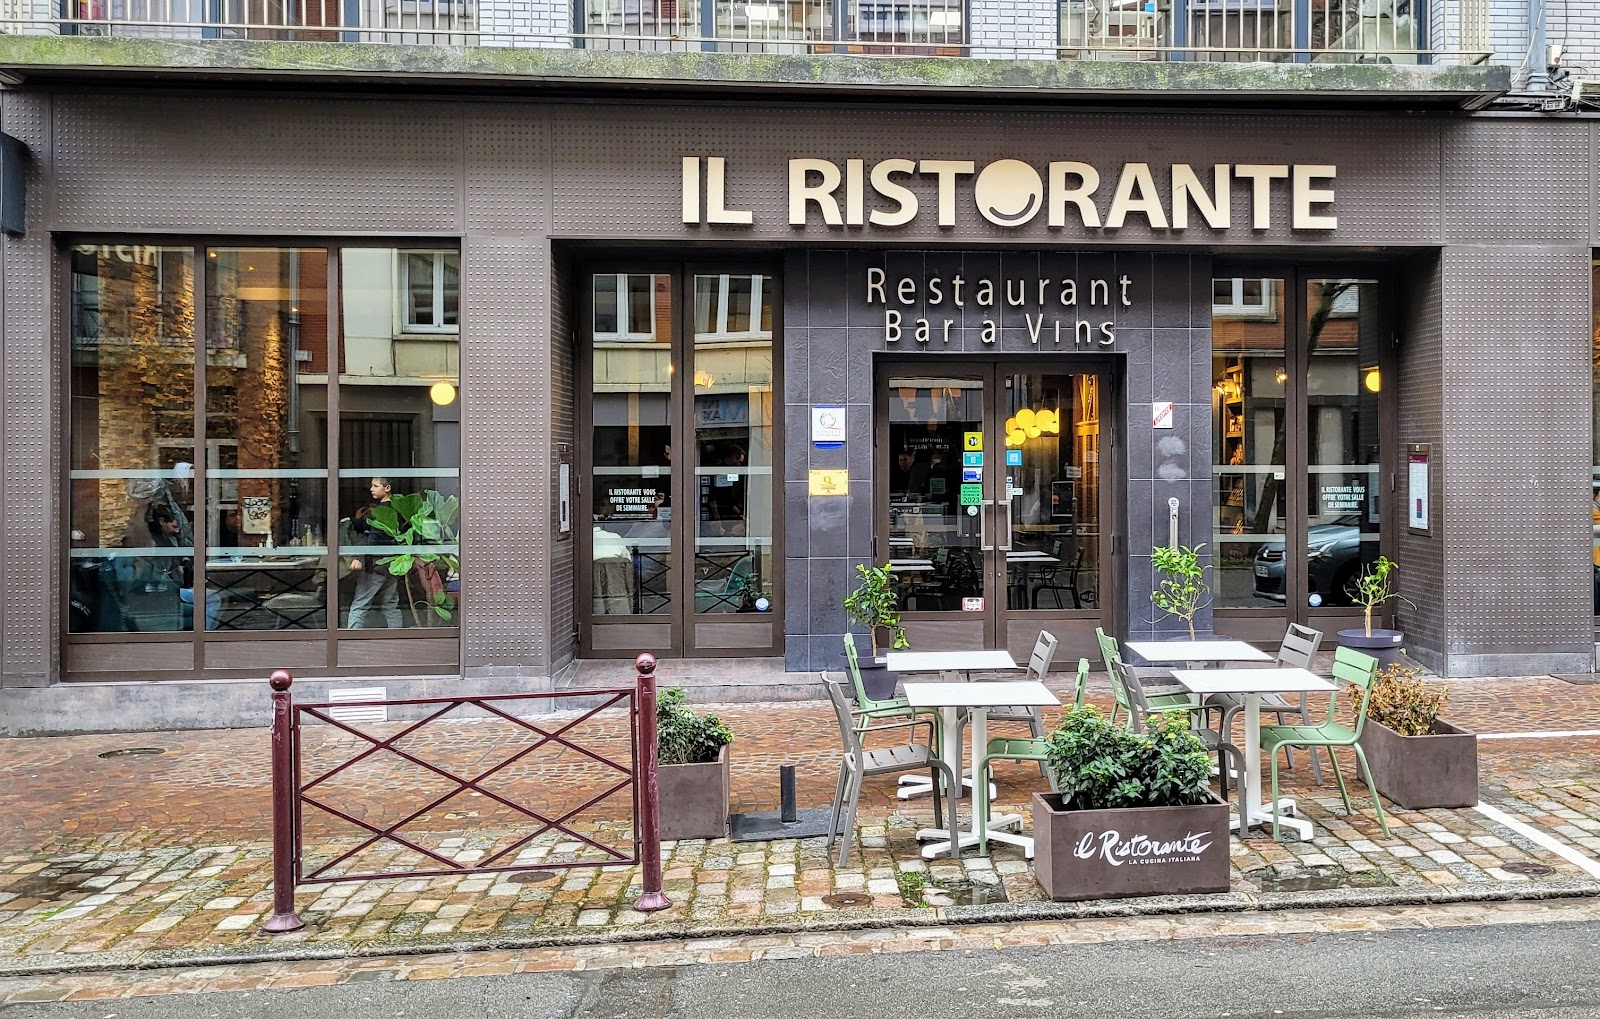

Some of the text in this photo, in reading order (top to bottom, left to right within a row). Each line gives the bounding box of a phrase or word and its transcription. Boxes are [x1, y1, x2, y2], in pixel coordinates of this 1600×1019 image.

[682, 156, 1338, 230] IL RISTORANTE
[867, 268, 1132, 307] Restaurant
[885, 309, 1116, 346] Bar a Vins
[1073, 830, 1213, 866] il Ristorante
[1168, 855, 1201, 864] ITALIANA
